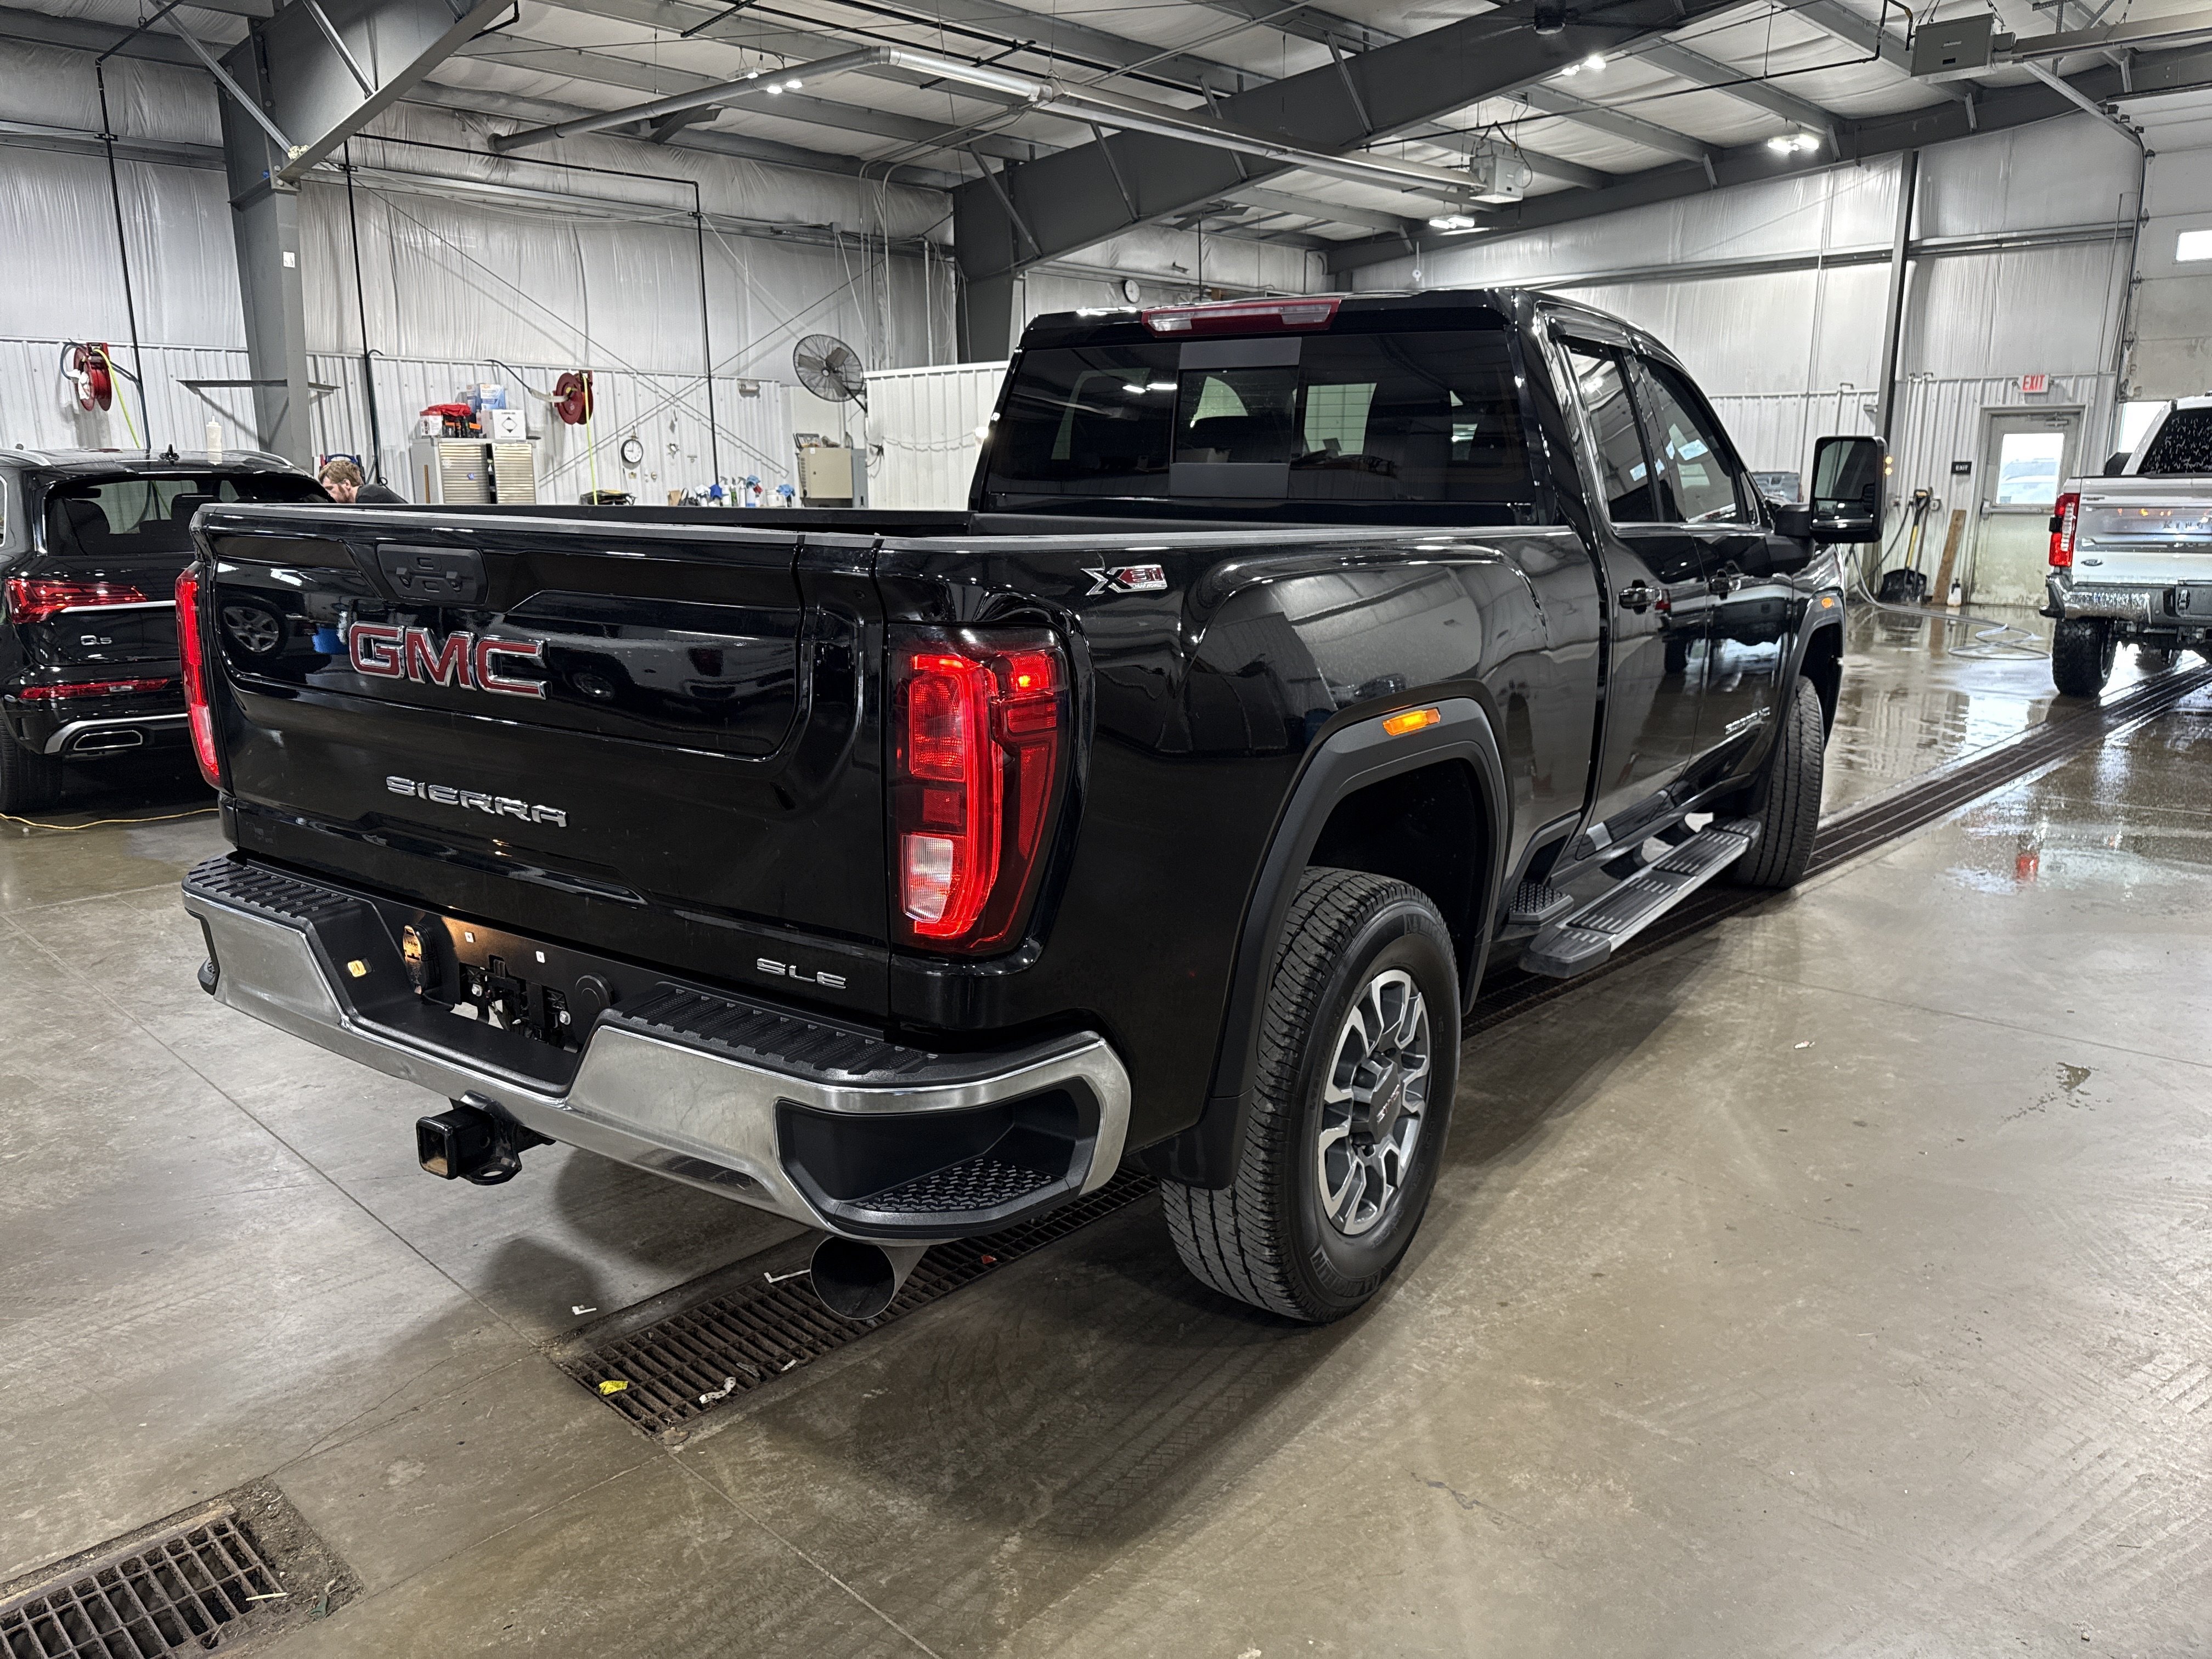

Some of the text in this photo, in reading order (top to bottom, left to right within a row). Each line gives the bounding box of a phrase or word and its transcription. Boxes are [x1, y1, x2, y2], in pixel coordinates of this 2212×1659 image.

[2023, 374, 2045, 391] EXIT
[80, 635, 112, 646] Q5
[349, 620, 548, 700] GMC
[386, 776, 567, 827] SIERRA
[757, 958, 847, 989] SLE
